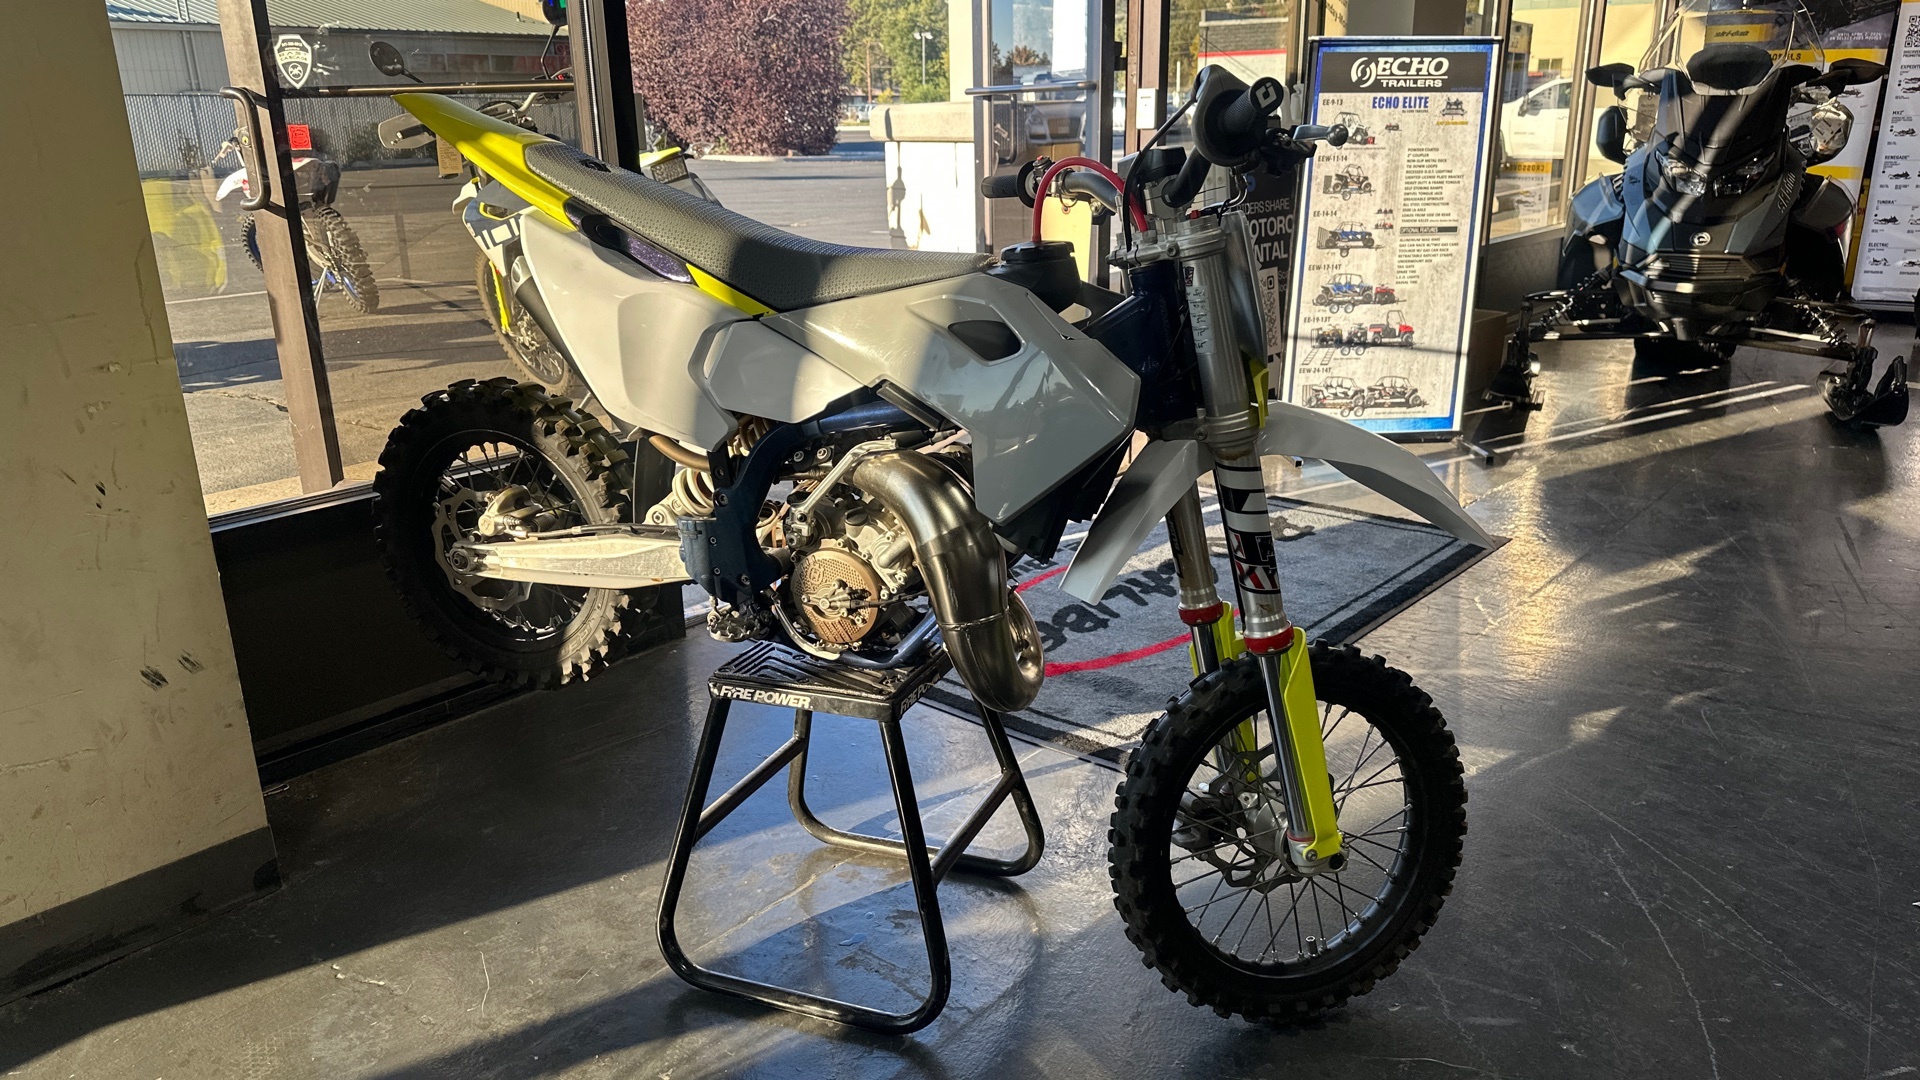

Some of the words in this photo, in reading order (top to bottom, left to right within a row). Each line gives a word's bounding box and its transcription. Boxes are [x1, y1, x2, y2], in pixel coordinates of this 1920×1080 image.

[1377, 57, 1449, 76] ECHO
[1381, 79, 1443, 88] TRAILERS
[1372, 97, 1400, 109] ECHO
[1402, 96, 1429, 109] ELITE
[1265, 198, 1290, 213] SHARE
[1249, 214, 1295, 238] OTORC
[1254, 240, 1288, 263] NTAL
